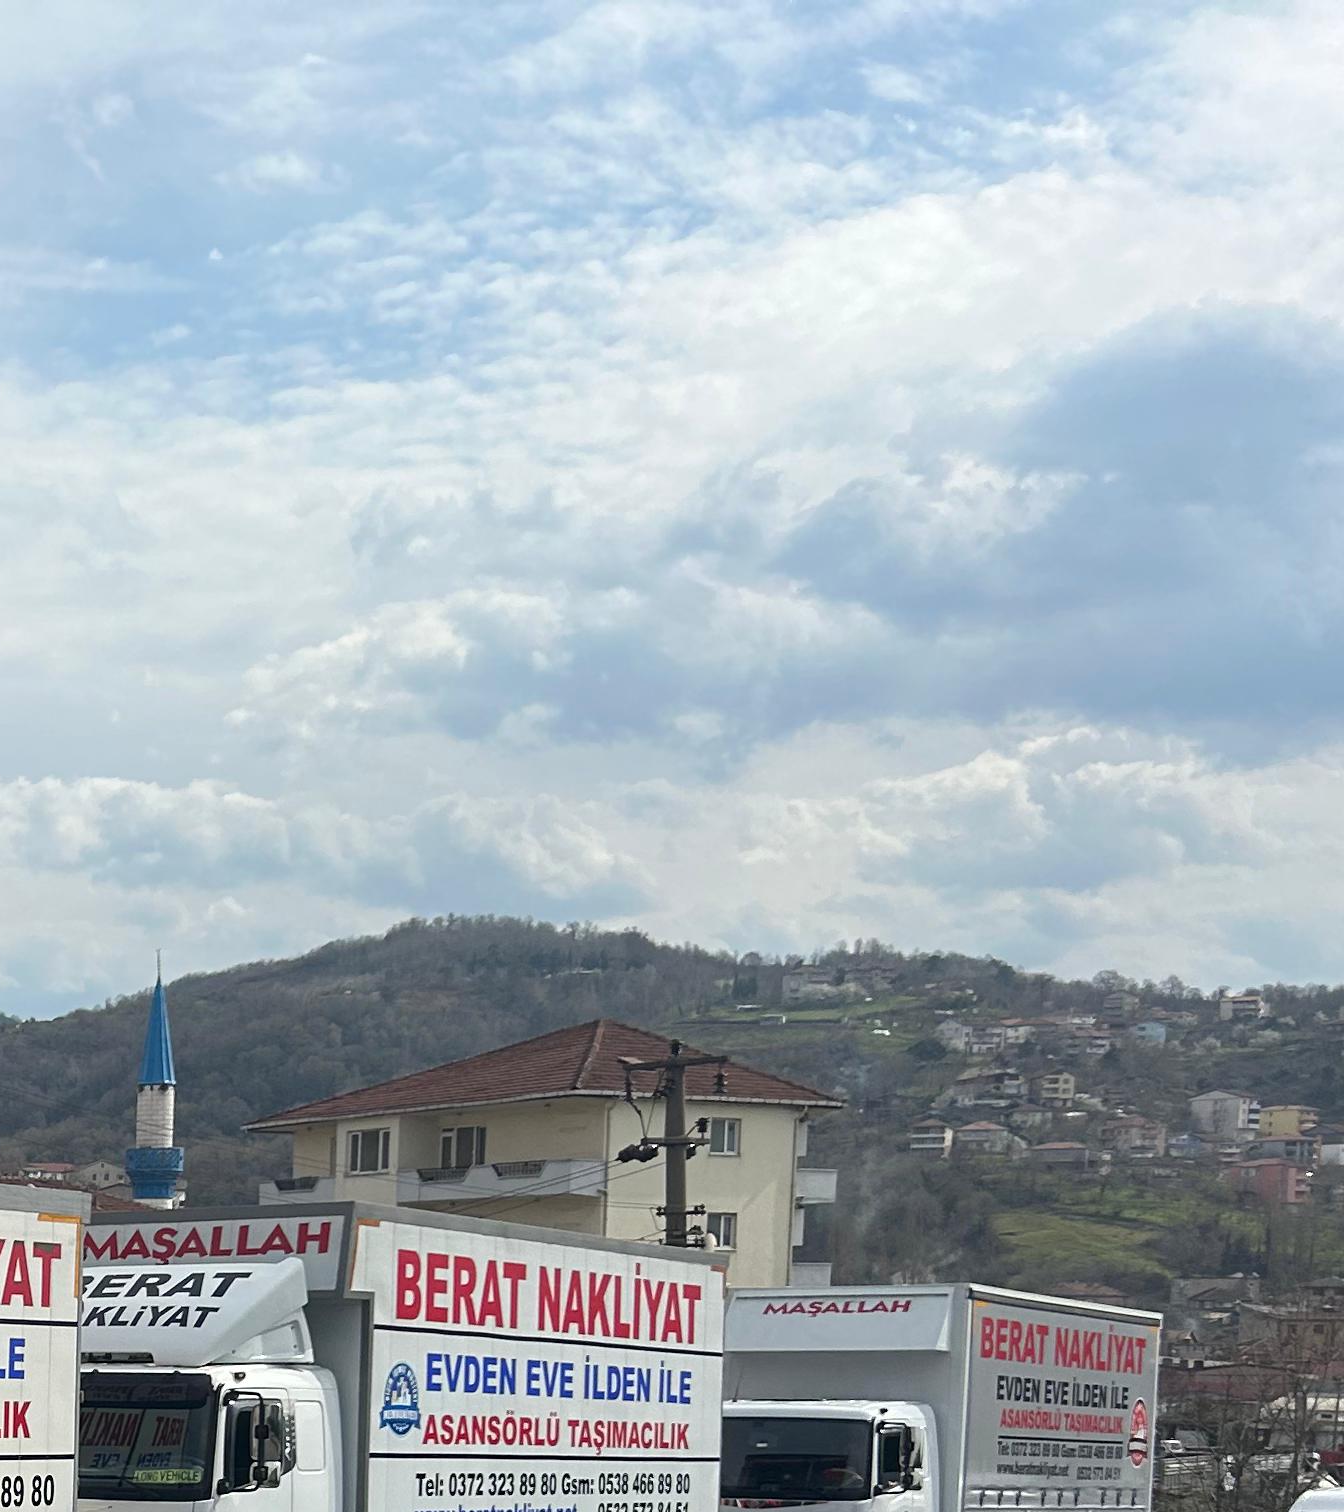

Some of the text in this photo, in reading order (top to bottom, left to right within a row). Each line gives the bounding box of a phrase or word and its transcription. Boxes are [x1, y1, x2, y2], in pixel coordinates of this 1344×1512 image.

[83, 1222, 331, 1265] MAŞALLAH
[395, 1249, 701, 1344] BERAT NAKLİYAT
[762, 1299, 912, 1318] MAŞALLAH
[980, 1317, 1147, 1375] BERAT NAKLİYAT
[426, 1353, 515, 1397] EVDEN
[526, 1359, 573, 1399] EVE
[584, 1355, 651, 1403] İLDEN
[659, 1361, 691, 1405] İLE
[996, 1375, 1129, 1409] EVDEN EVE İLDEN İLE
[422, 1410, 690, 1455] ASANSÖRLÜ TAŞIMACILIK
[1000, 1406, 1061, 1429] ASANSÖRLÜ
[1064, 1413, 1124, 1436] TAŞIMACILIK
[0, 1475, 25, 1509] 89
[30, 1474, 55, 1508] 80
[161, 1470, 200, 1482] VEHICLE
[416, 1473, 690, 1497] Tel: 0372 323 89 80 Gsm: 0538 466 89 80
